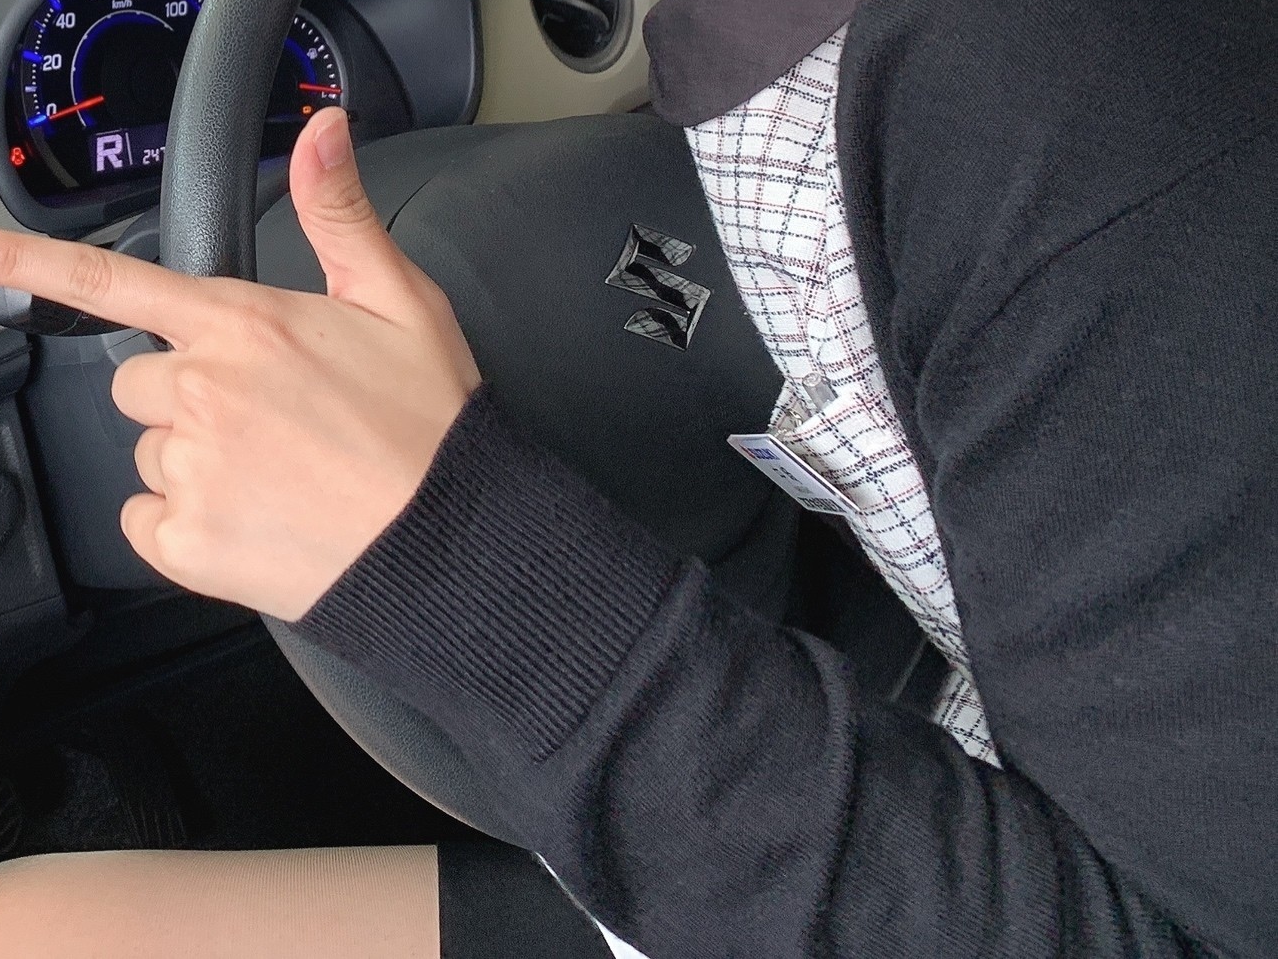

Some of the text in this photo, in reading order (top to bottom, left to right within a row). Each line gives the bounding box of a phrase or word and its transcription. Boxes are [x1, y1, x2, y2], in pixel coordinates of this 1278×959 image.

[165, 0, 188, 18] 100
[55, 12, 76, 30] 40
[42, 53, 62, 72] 20
[45, 102, 58, 117] 0
[95, 133, 124, 173] R
